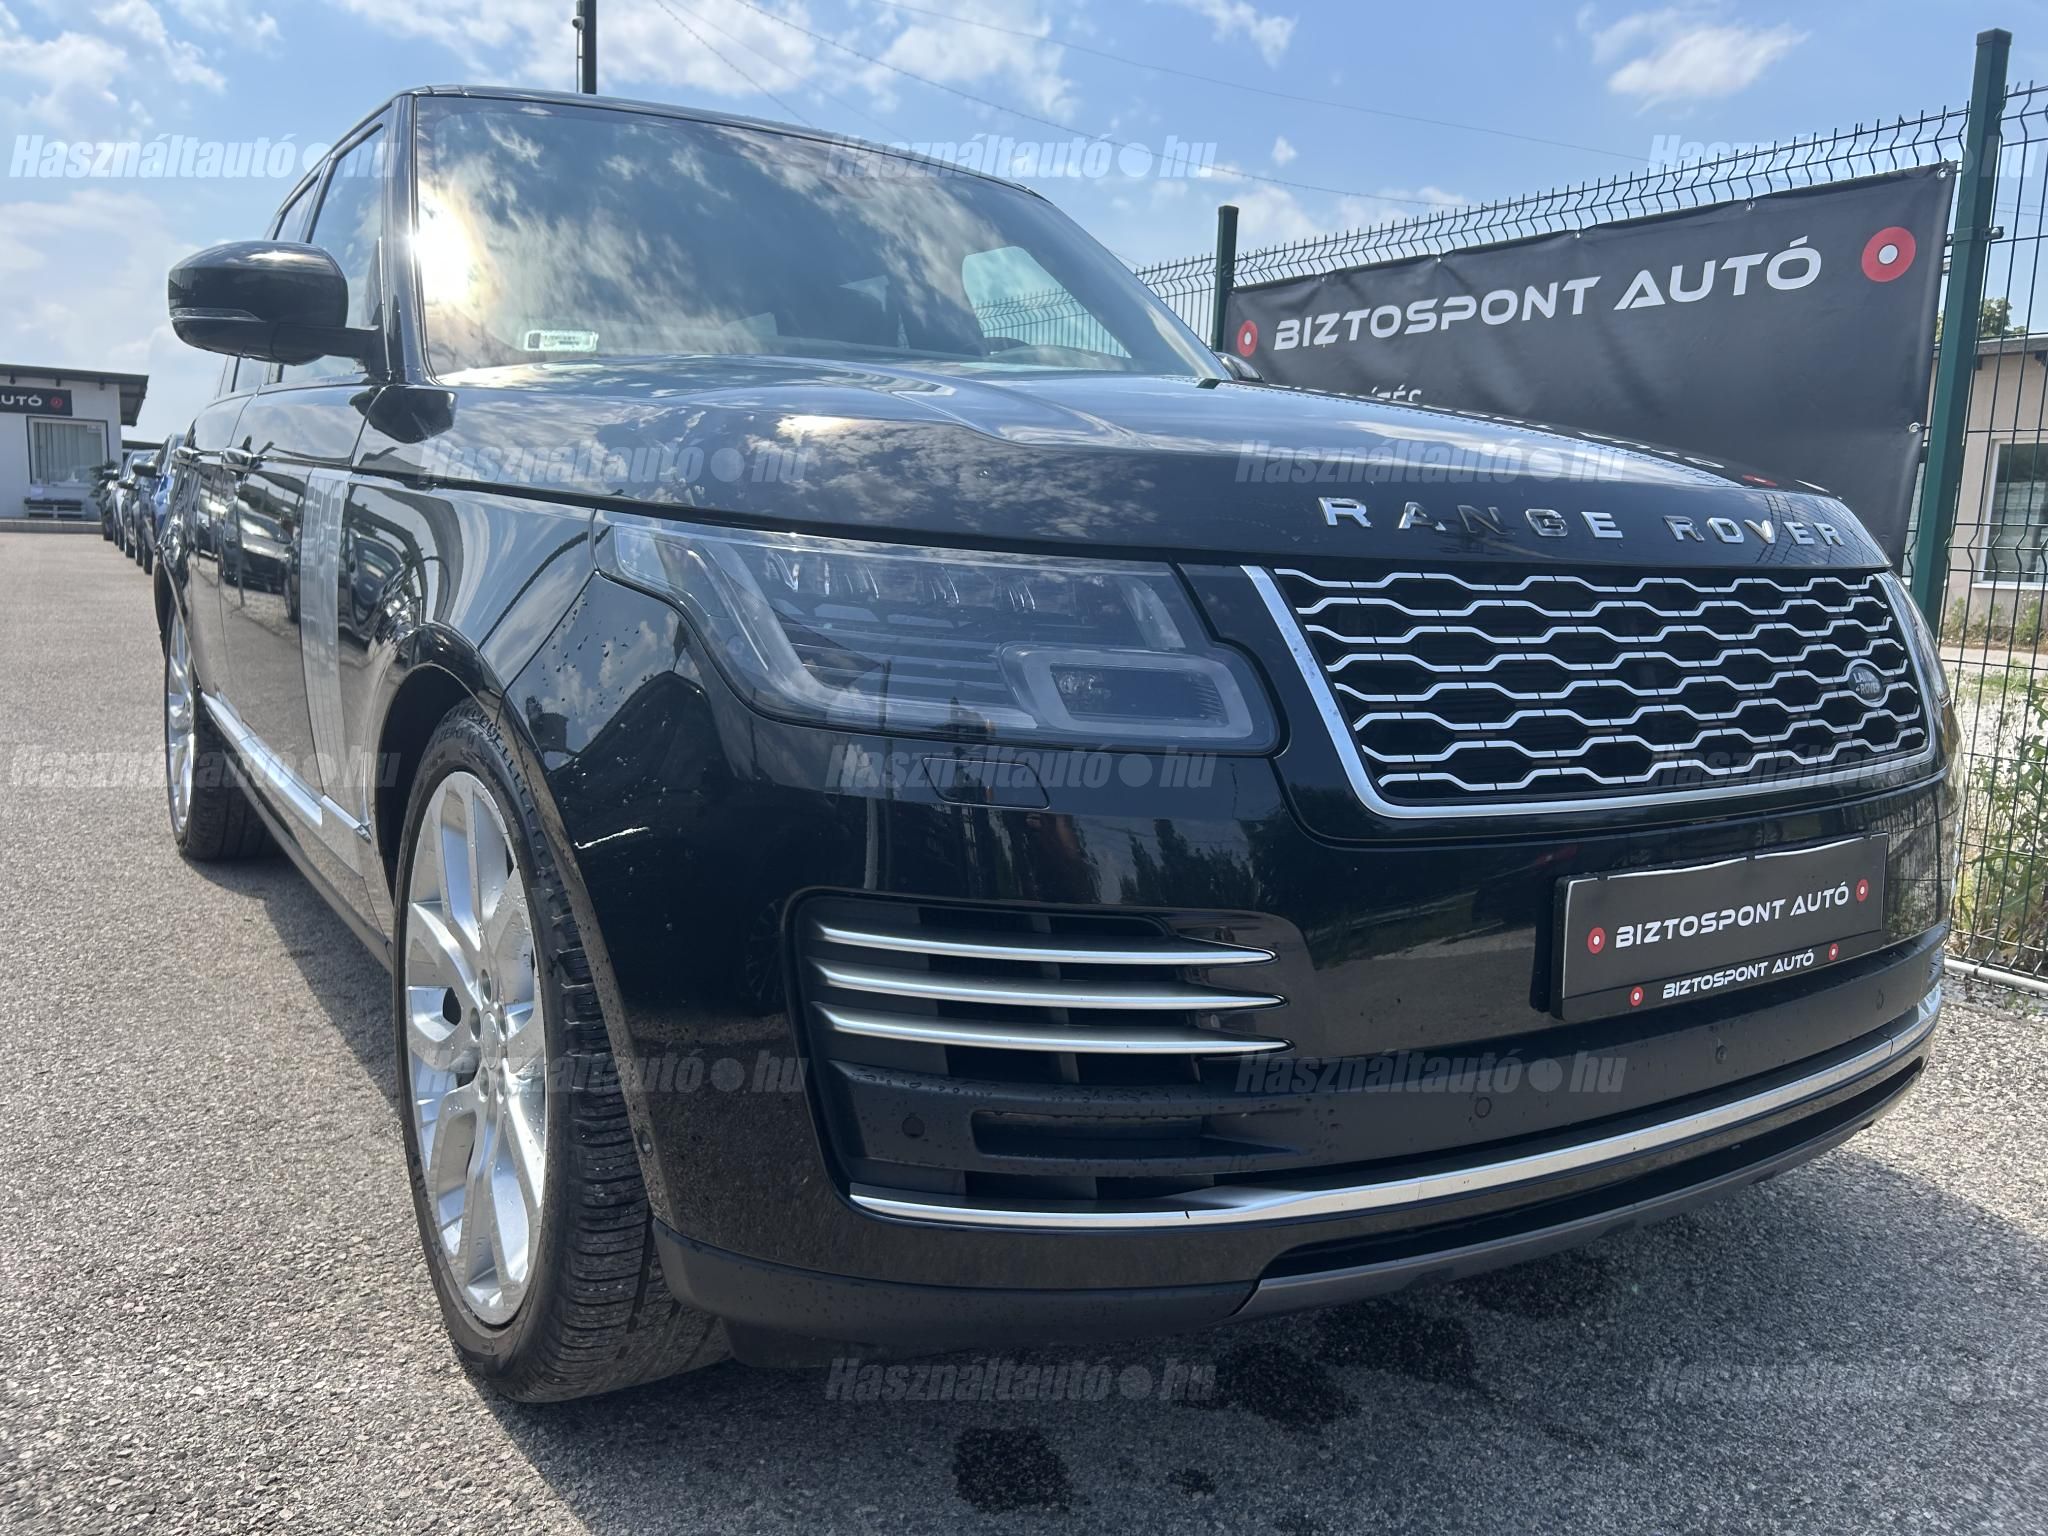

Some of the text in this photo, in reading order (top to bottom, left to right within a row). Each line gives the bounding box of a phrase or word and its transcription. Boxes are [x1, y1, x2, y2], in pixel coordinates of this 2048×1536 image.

[1273, 236, 1822, 350] BIZTOSPONT AUTÓ
[0, 394, 42, 406] UTÓ
[1318, 497, 1845, 546] RANGE ROVER
[1616, 881, 1849, 948] BIZTOSPONT AUTÓ
[1663, 949, 1814, 999] BIZTOSPONT AUTÓ
